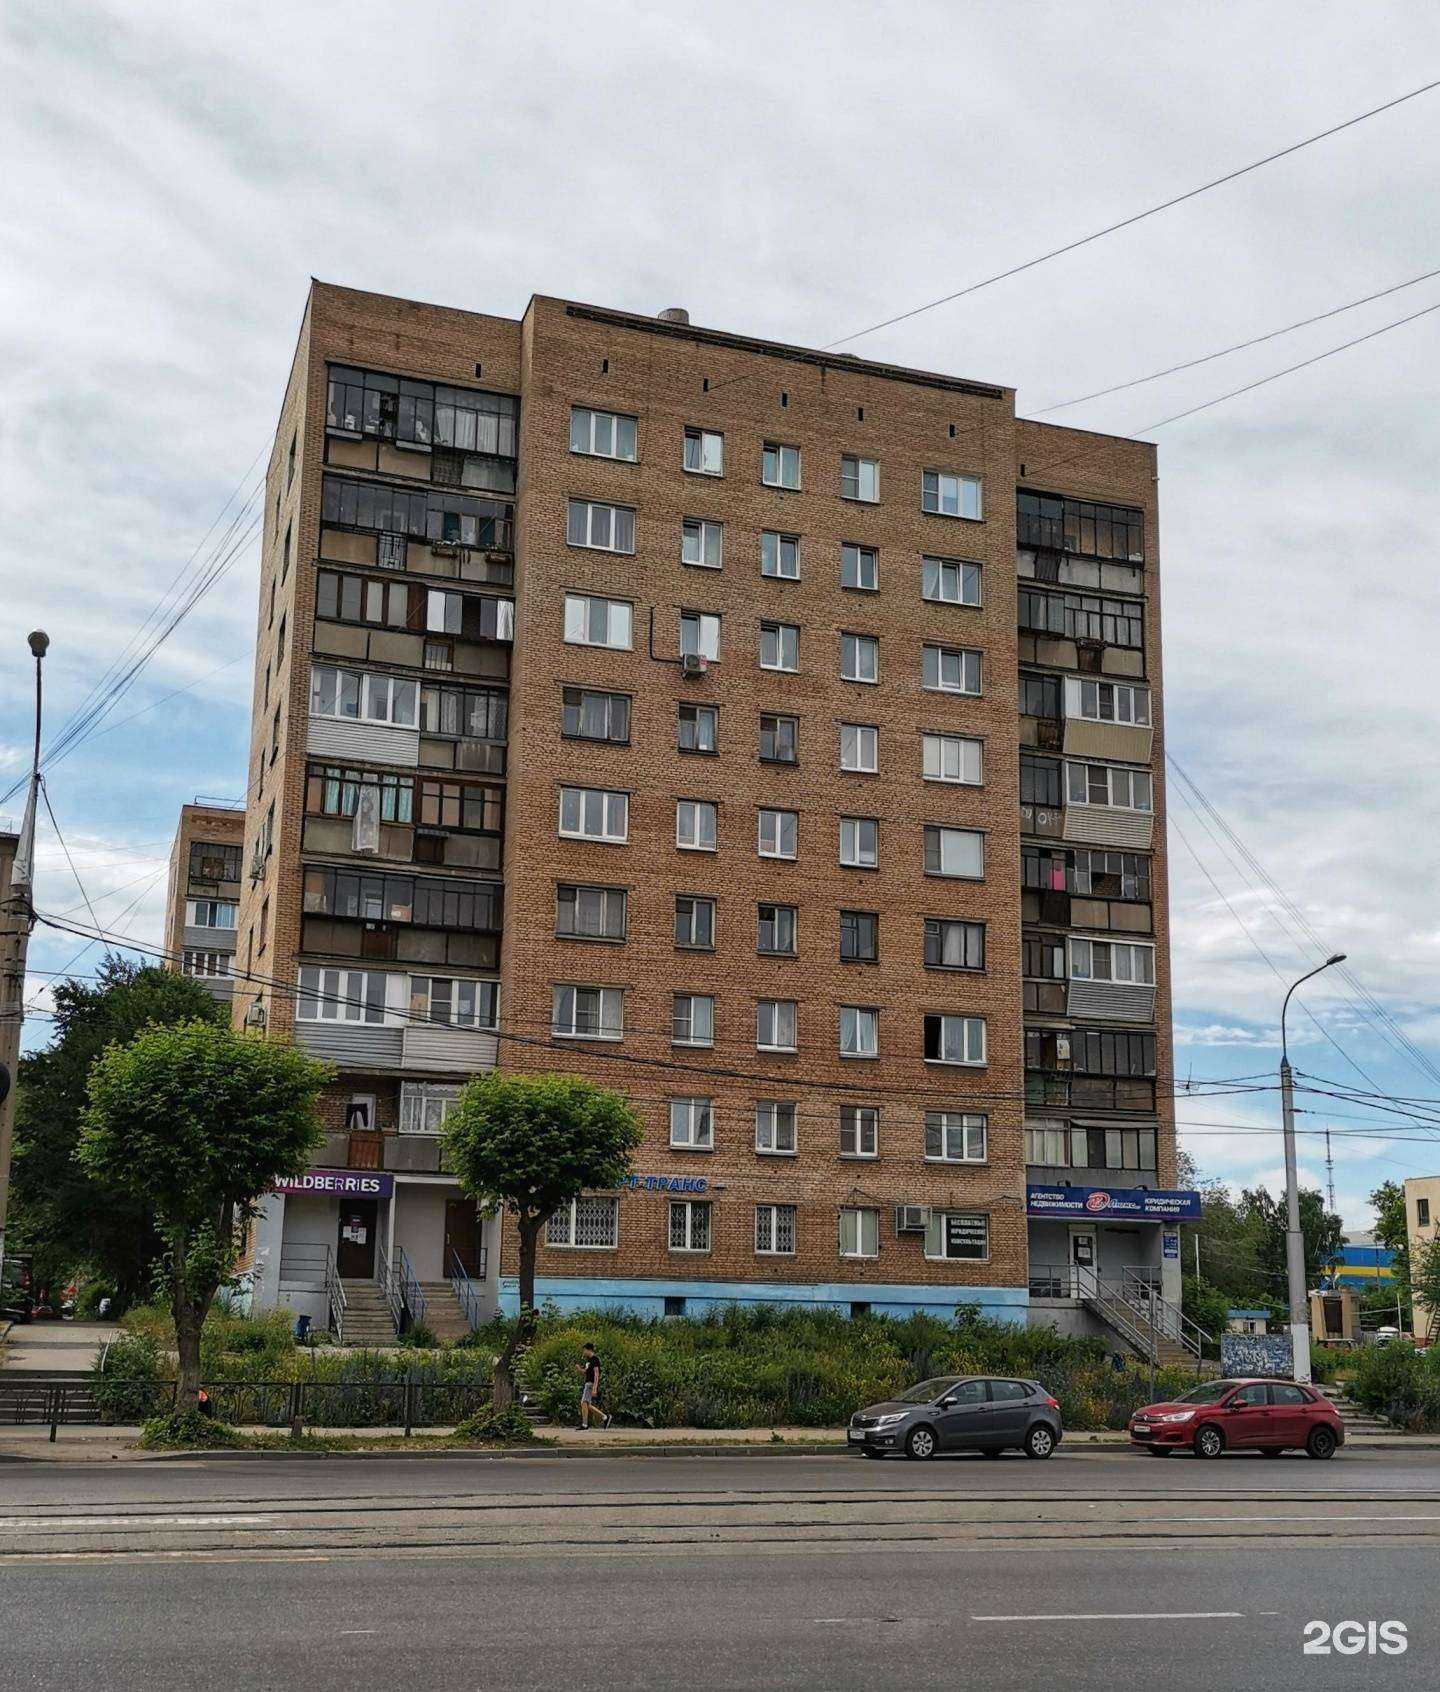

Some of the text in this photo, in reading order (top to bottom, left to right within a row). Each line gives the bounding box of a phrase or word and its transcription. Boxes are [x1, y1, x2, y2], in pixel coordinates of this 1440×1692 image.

[274, 1174, 381, 1193] WILDBERRIES
[1030, 1192, 1065, 1200] АГЕНТСТВО
[1030, 1200, 1083, 1209] НЕДВИЖИМОСТИ
[1144, 1198, 1191, 1206] ЮРИДИЧЕСКАЯ
[1144, 1205, 1180, 1213] КОМПАНИЯ
